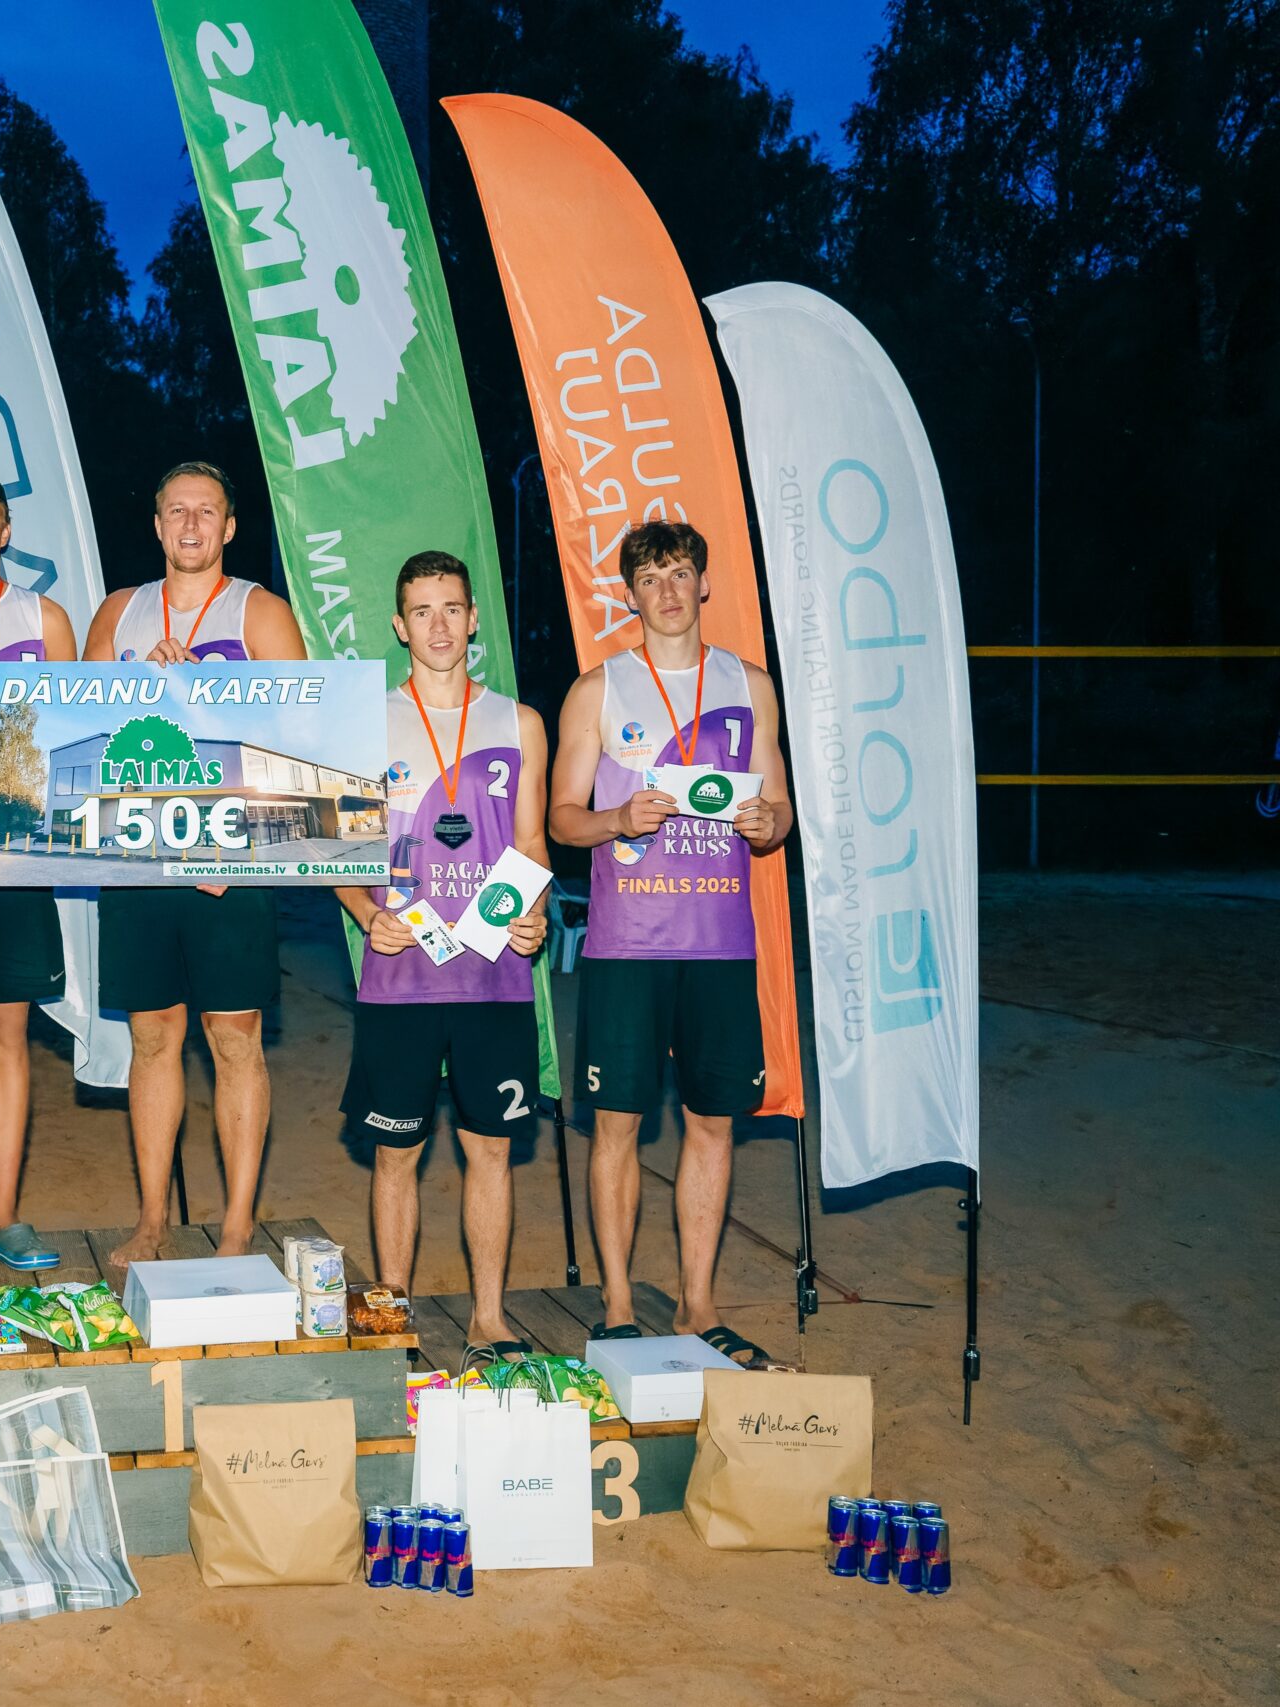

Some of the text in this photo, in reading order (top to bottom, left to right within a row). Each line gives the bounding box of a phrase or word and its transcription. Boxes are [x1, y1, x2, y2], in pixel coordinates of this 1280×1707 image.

[0, 672, 325, 706] DĀVANU KARTE
[724, 717, 743, 758] 1
[99, 758, 224, 788] LAIMAS
[486, 758, 511, 799] 2
[71, 795, 249, 851] 150€
[664, 819, 735, 838] RAGAN
[663, 838, 732, 858] KAUSS
[183, 863, 386, 877] www.elaimas.lv SIALAIMAS
[617, 873, 741, 894] FINĀLS 2025
[587, 1064, 601, 1092] 5
[496, 1079, 531, 1122] 2
[369, 1113, 421, 1132] AUTO KADA
[150, 1360, 184, 1453] 1
[591, 1440, 641, 1526] 3
